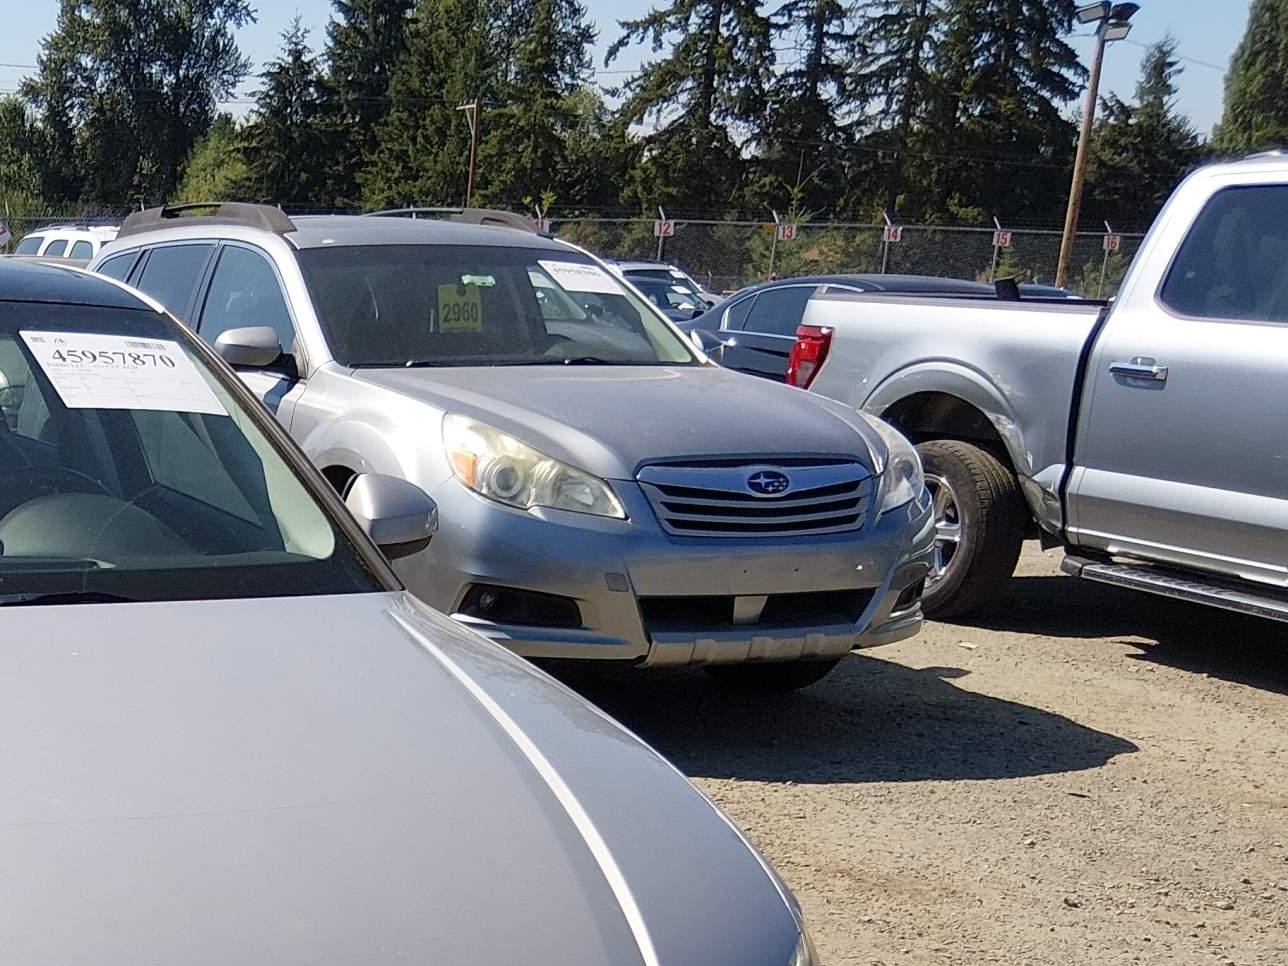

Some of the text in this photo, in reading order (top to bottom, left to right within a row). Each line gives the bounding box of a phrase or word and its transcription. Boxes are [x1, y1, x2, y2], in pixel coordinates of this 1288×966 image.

[658, 221, 671, 235] 12
[782, 225, 793, 239] 13
[887, 227, 898, 241] 14
[996, 231, 1008, 245] 15
[1107, 235, 1117, 249] 16
[442, 302, 479, 323] 2960
[52, 349, 177, 369] 45957870
